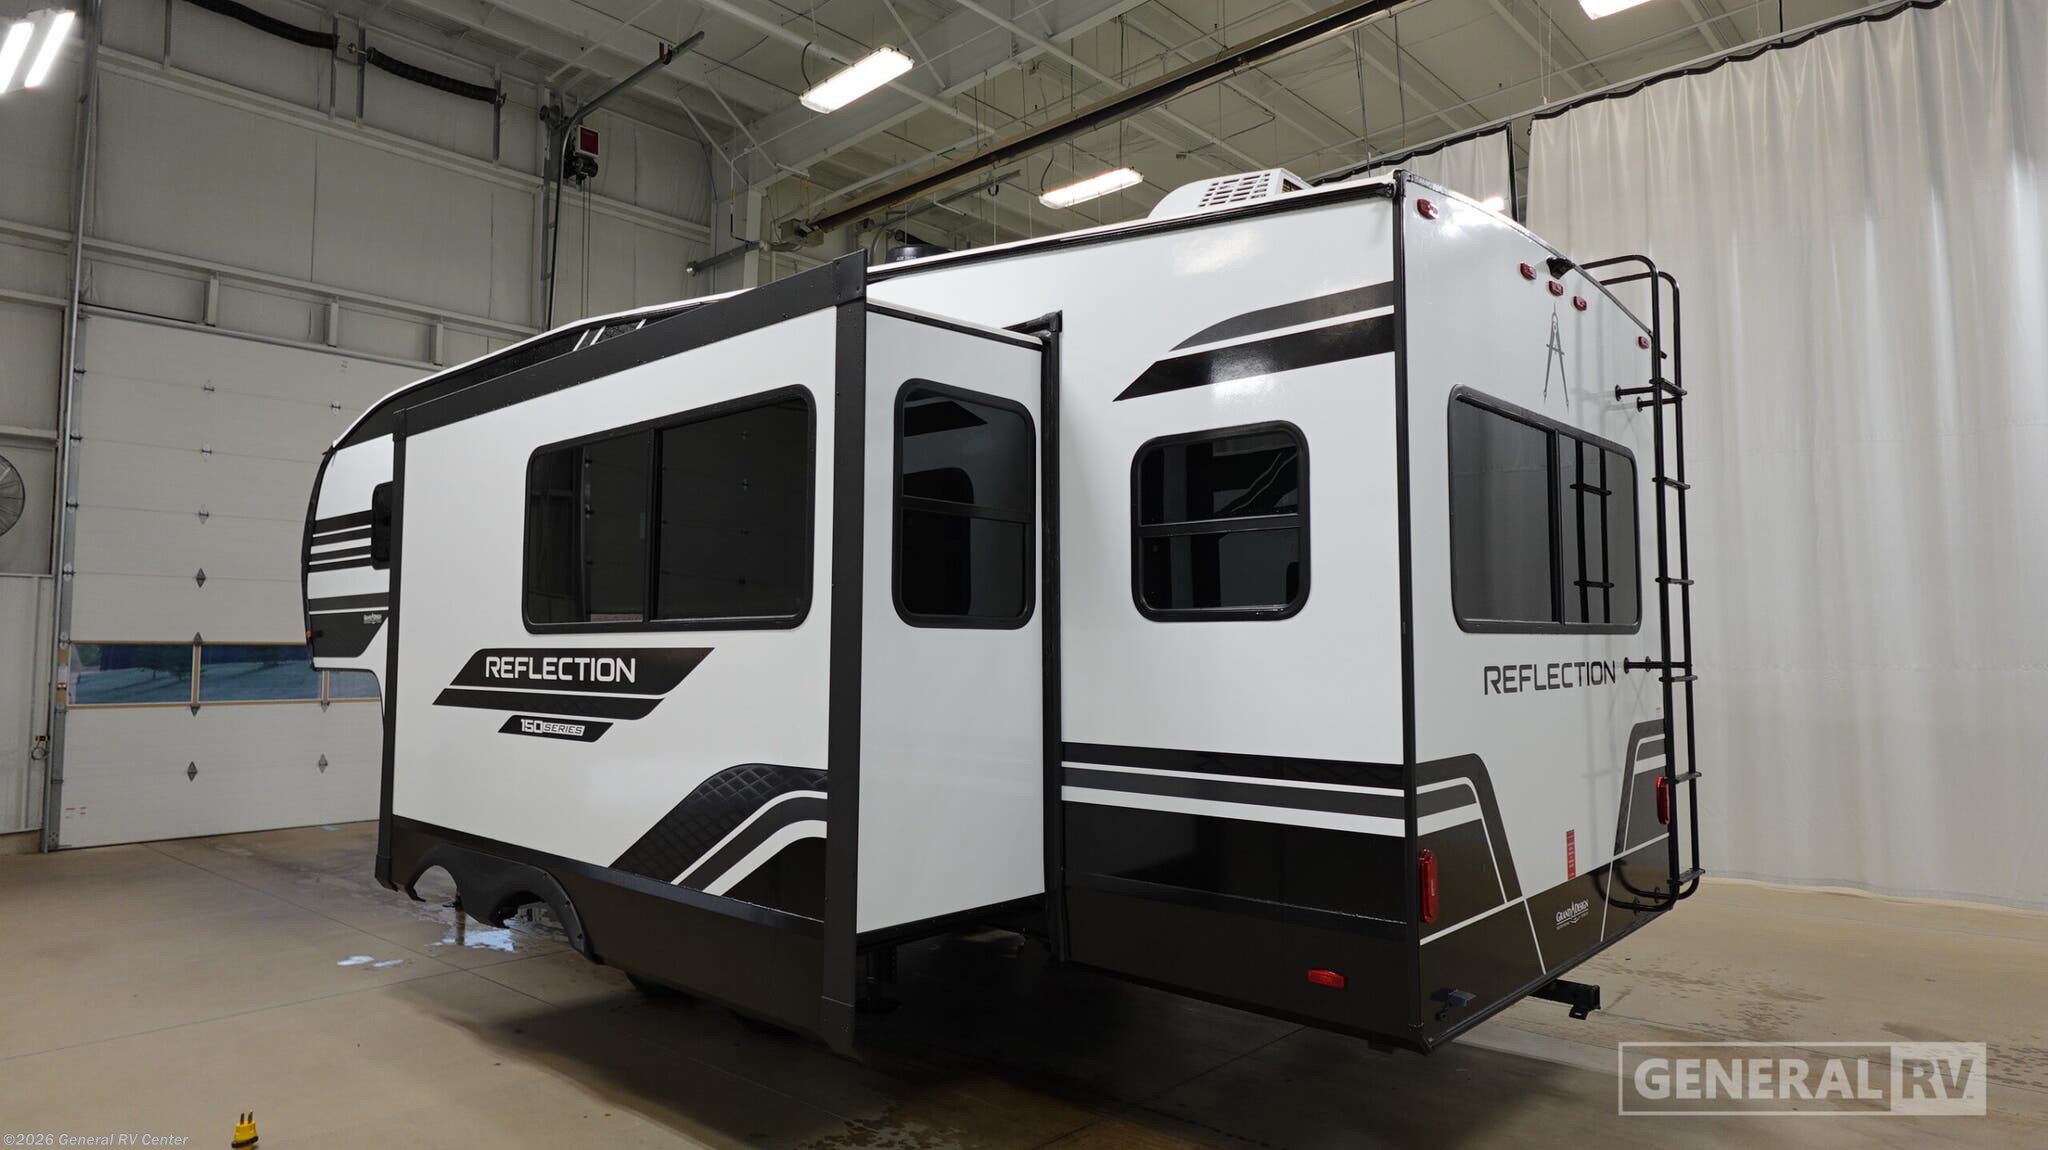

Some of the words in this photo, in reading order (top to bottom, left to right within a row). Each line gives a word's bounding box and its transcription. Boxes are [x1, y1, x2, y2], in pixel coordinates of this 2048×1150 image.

[485, 656, 636, 683] REFLECTION
[1484, 660, 1616, 695] REFLECTION
[520, 718, 543, 734] 150
[543, 723, 583, 736] SERIES
